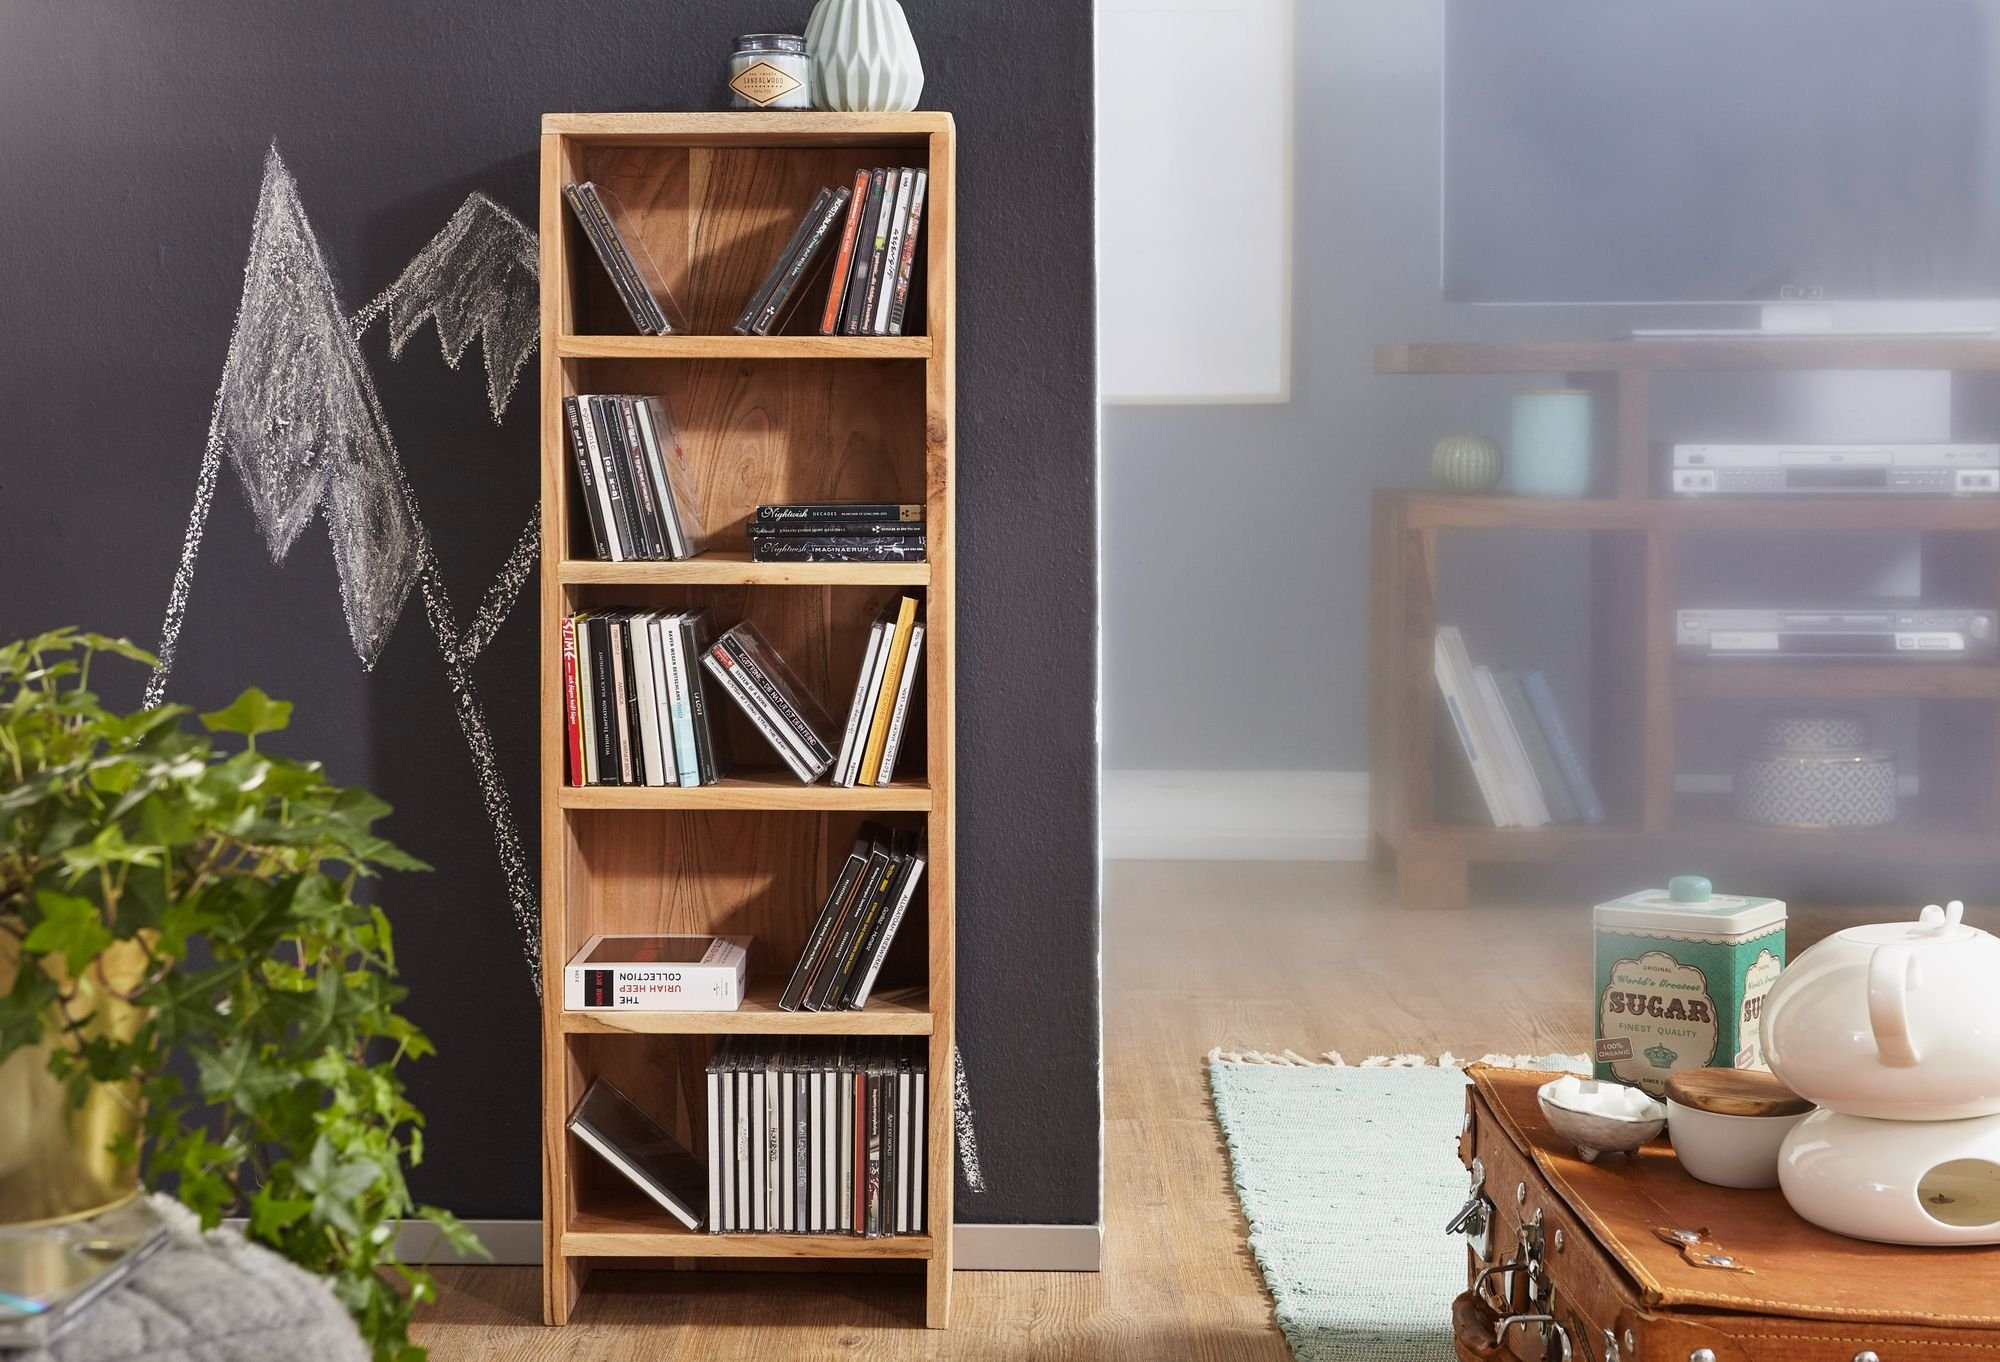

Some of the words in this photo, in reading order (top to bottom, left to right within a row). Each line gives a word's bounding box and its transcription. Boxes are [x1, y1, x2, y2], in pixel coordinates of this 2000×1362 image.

[582, 408, 595, 449] egotronic
[761, 506, 808, 521] Nightwish
[760, 542, 807, 556] Nightwish
[562, 619, 575, 662] SLIME
[672, 666, 681, 701] DEUTSCHLAND
[734, 669, 750, 686] SYSTEM
[755, 694, 768, 708] DOWN
[737, 652, 764, 682] EGOTRONIC
[762, 682, 773, 693] DIE
[769, 690, 787, 711] NATUR
[784, 708, 795, 719] IST
[791, 717, 805, 732] DEIN
[800, 728, 817, 746] FEIND
[600, 699, 609, 732] TEMPTATION
[880, 744, 895, 778] EGOTRONIC
[890, 723, 899, 741] MACHT
[876, 905, 889, 925] Gorillaz
[888, 894, 908, 932] ALLIGATOAH
[865, 930, 878, 952] Humanz
[871, 933, 891, 971] TRIEBWERKE
[619, 973, 682, 981] COLLECTION
[841, 959, 851, 974] MACHT
[1643, 965, 1672, 973] ORIGINAL
[1617, 975, 1656, 986] World's
[619, 996, 639, 1004] THE
[1609, 991, 1711, 1023] SUGAR
[1619, 1022, 1652, 1033] FINEST
[1657, 1027, 1697, 1038] QUALITY
[1599, 1049, 1631, 1057] ORGANIC
